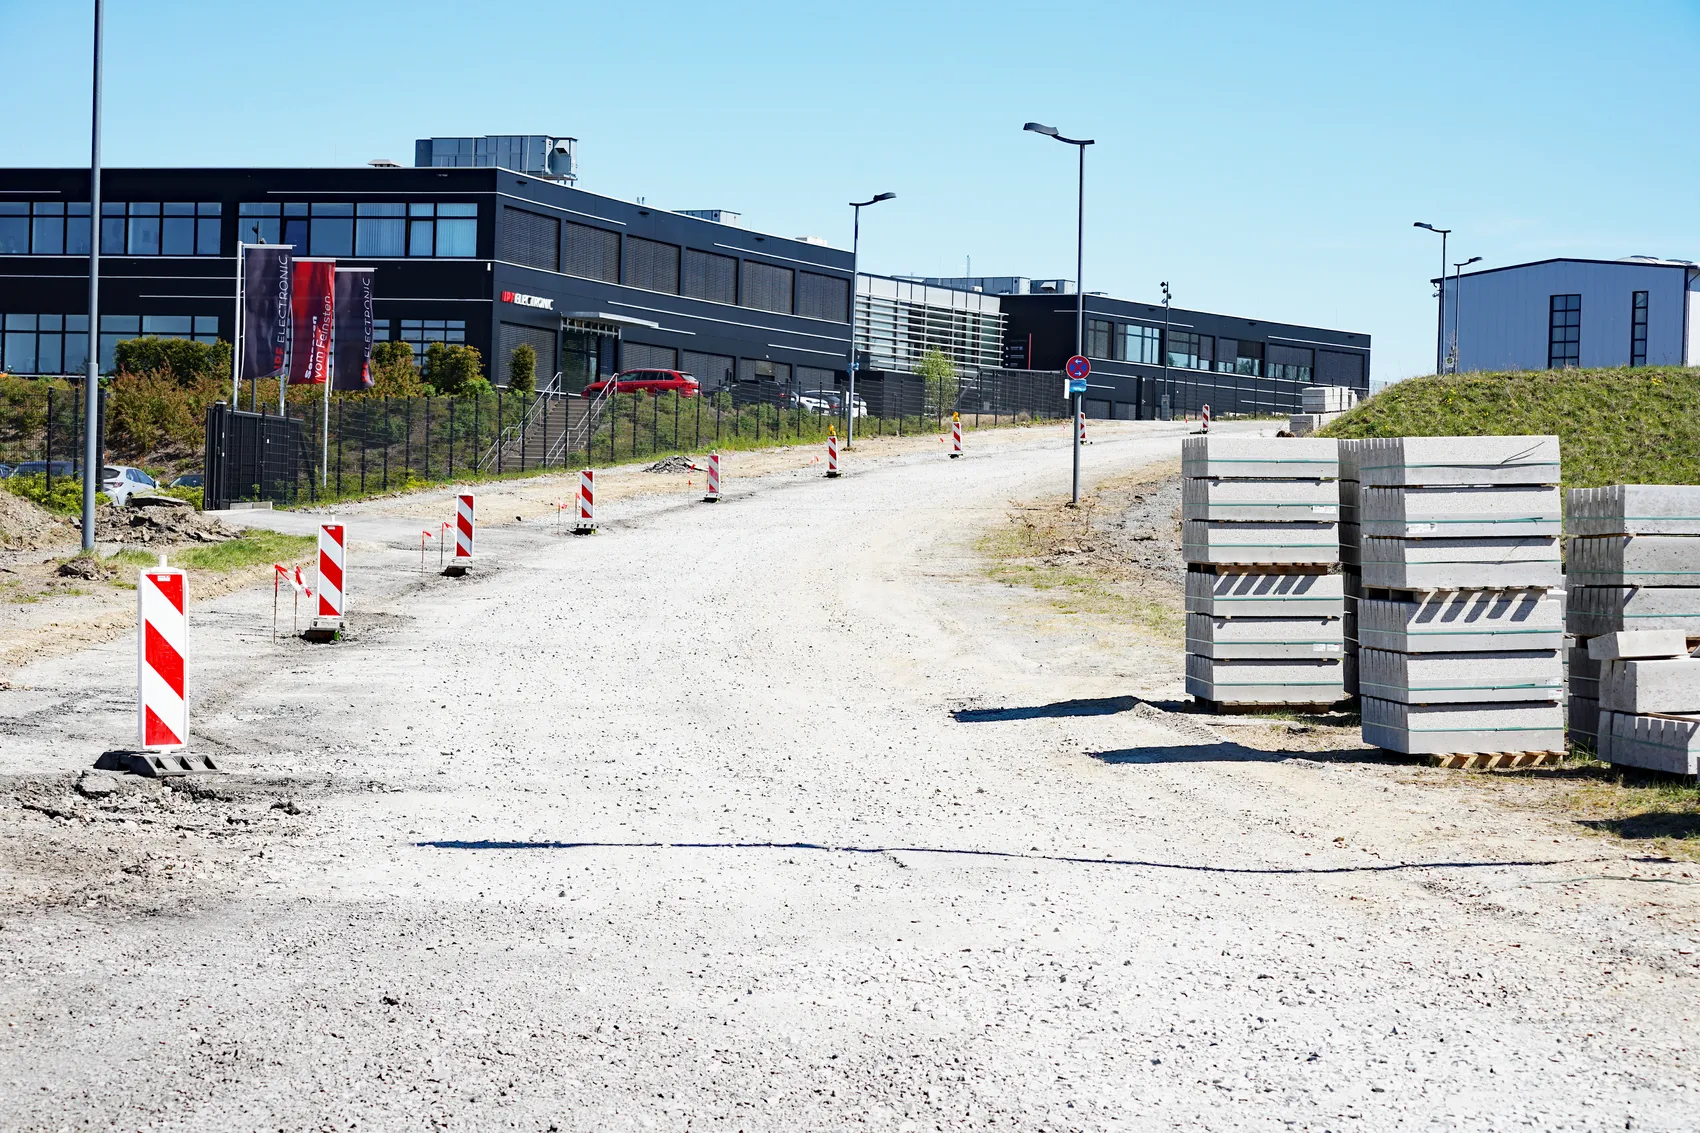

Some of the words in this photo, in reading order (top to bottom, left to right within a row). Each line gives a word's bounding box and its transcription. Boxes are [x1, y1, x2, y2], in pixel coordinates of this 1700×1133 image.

[277, 254, 289, 343] ELECTRONIC
[502, 291, 515, 303] IPF
[514, 293, 554, 310] ELECTRONIC
[315, 292, 331, 348] Feinsten.
[273, 346, 284, 369] IPF
[314, 351, 324, 378] vom
